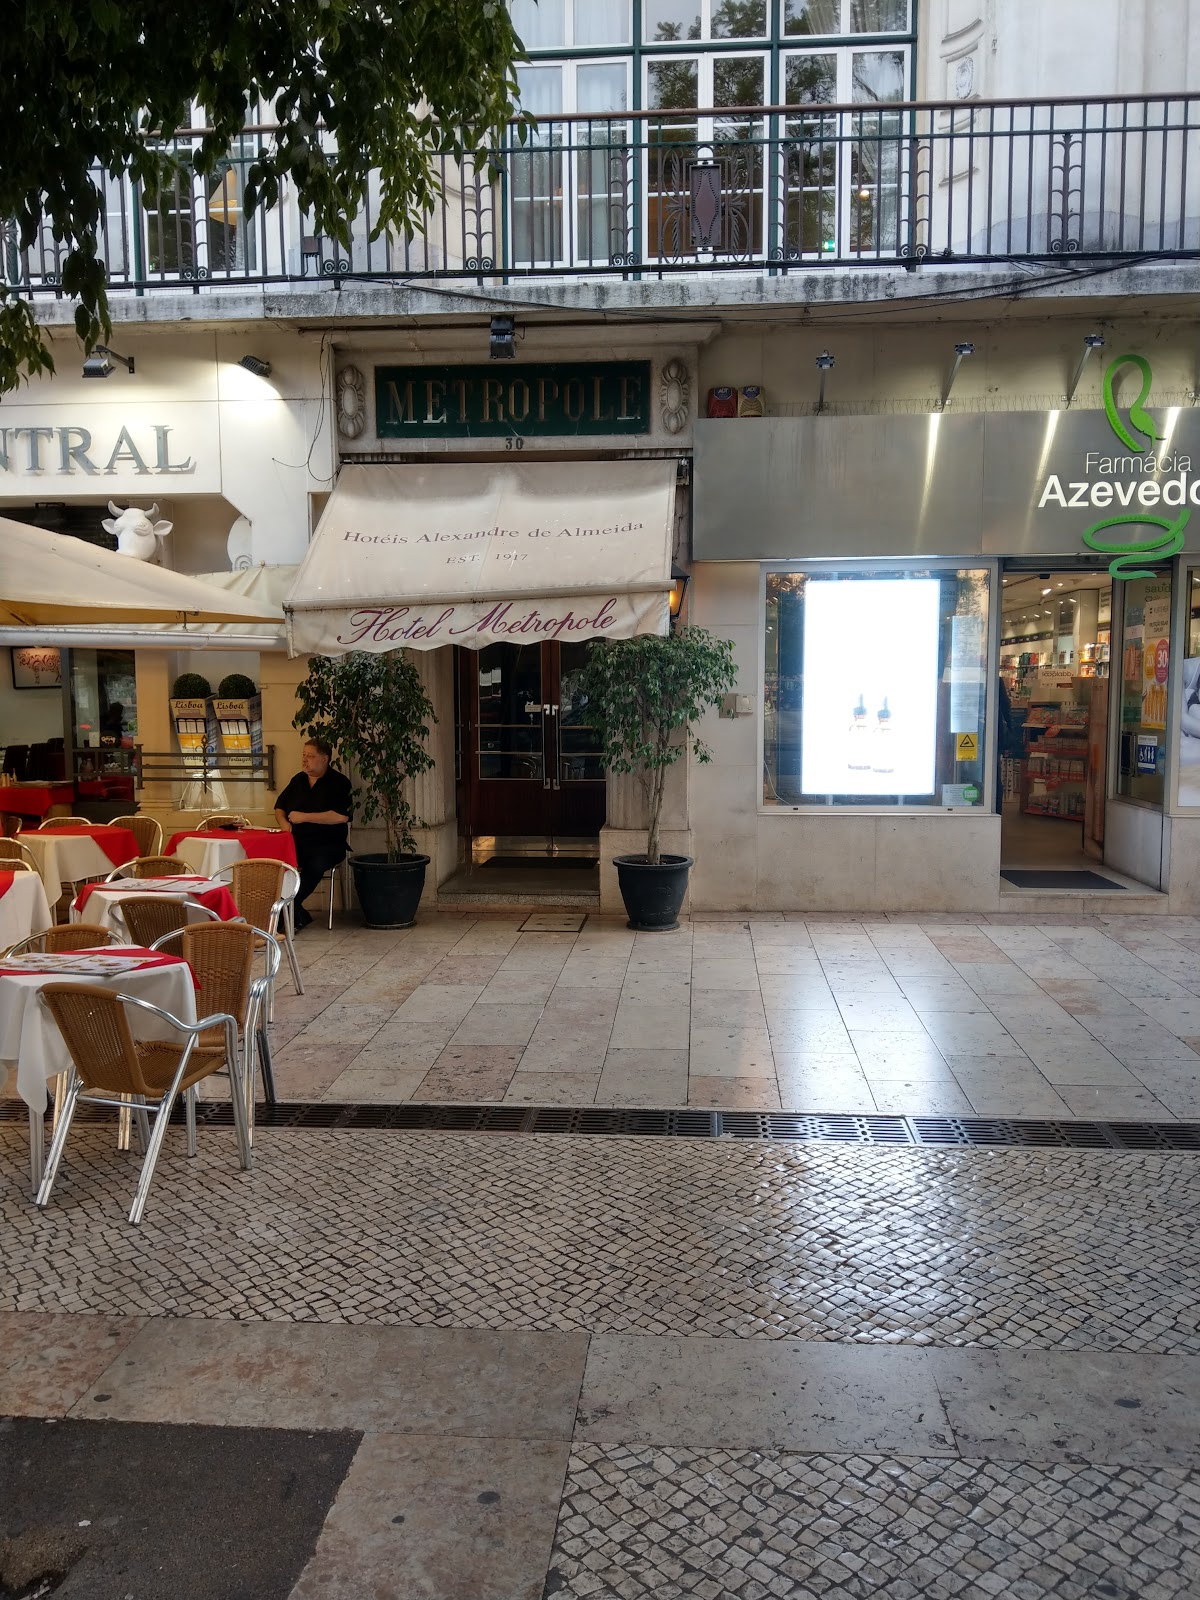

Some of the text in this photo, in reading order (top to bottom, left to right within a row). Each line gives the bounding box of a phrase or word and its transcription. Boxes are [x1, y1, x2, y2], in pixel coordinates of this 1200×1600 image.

[385, 376, 642, 424] METROPOLE
[505, 437, 524, 450] 30
[1086, 450, 1192, 474] Farmácia
[342, 521, 644, 544] Hotéis Alexandre de Almeida
[446, 553, 529, 564] EST. 1917
[336, 598, 618, 645] Hotel Métropole
[174, 700, 204, 709] Lisboa
[216, 701, 244, 710] Lisboa
